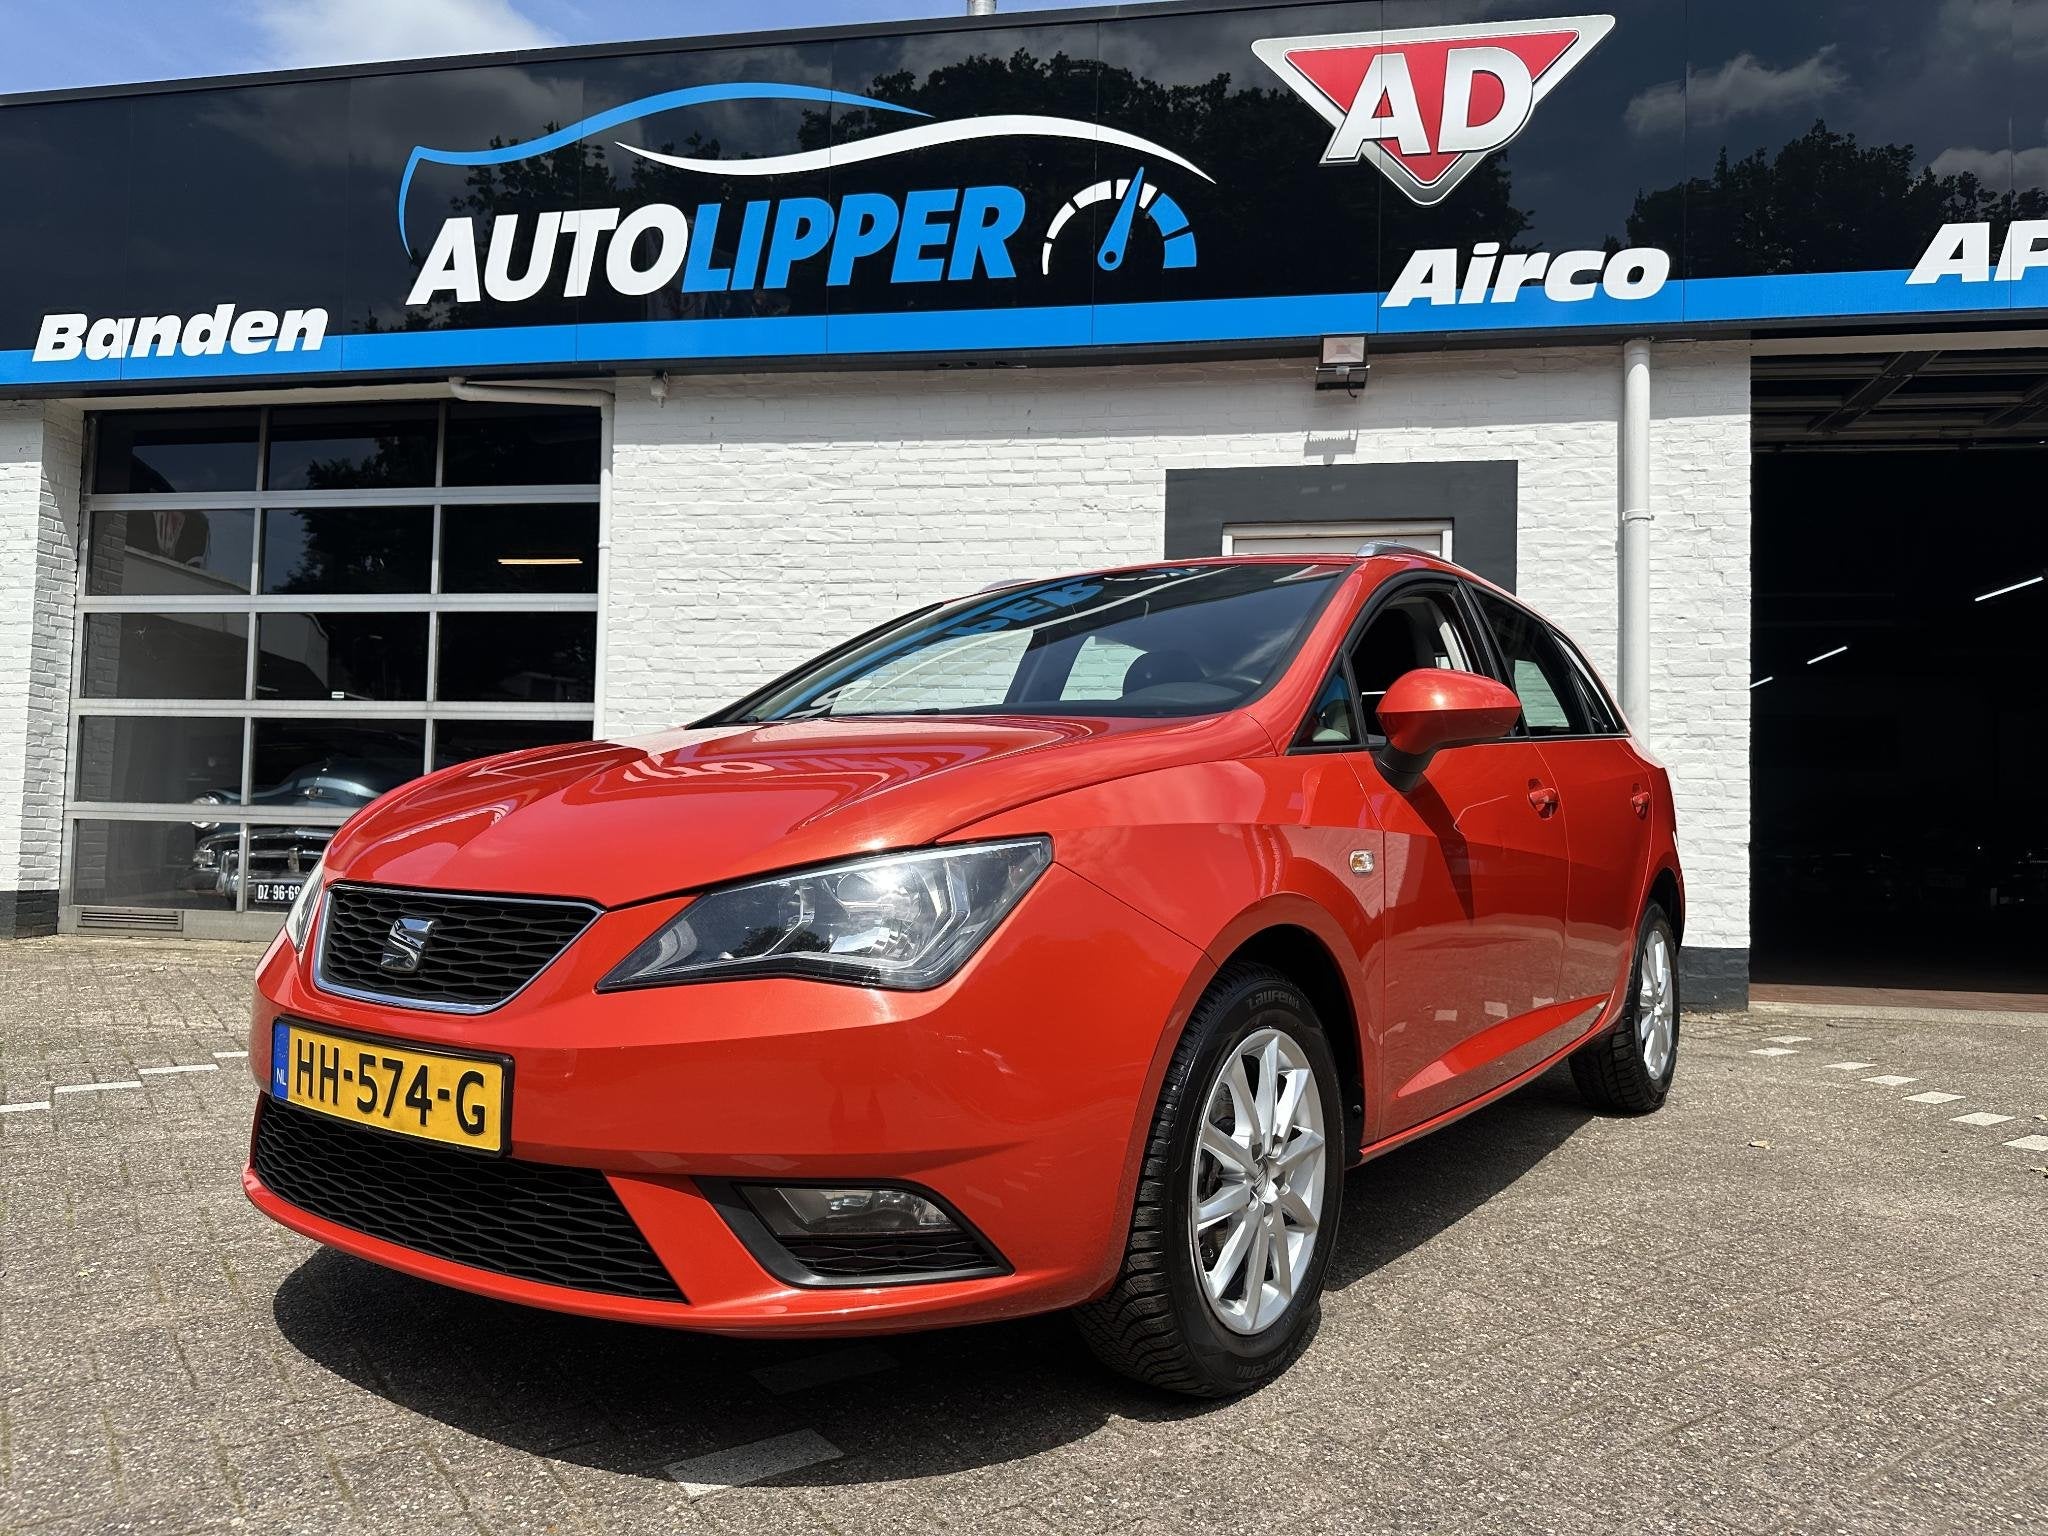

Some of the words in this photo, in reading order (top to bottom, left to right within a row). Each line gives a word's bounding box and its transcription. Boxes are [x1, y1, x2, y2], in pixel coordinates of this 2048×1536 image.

[1326, 46, 1533, 160] AD
[406, 185, 1026, 306] AUTOLIPPER
[1381, 242, 1670, 307] Airco
[32, 304, 329, 362] Banden
[276, 1069, 287, 1086] NL
[296, 1038, 486, 1136] HH-574-G
